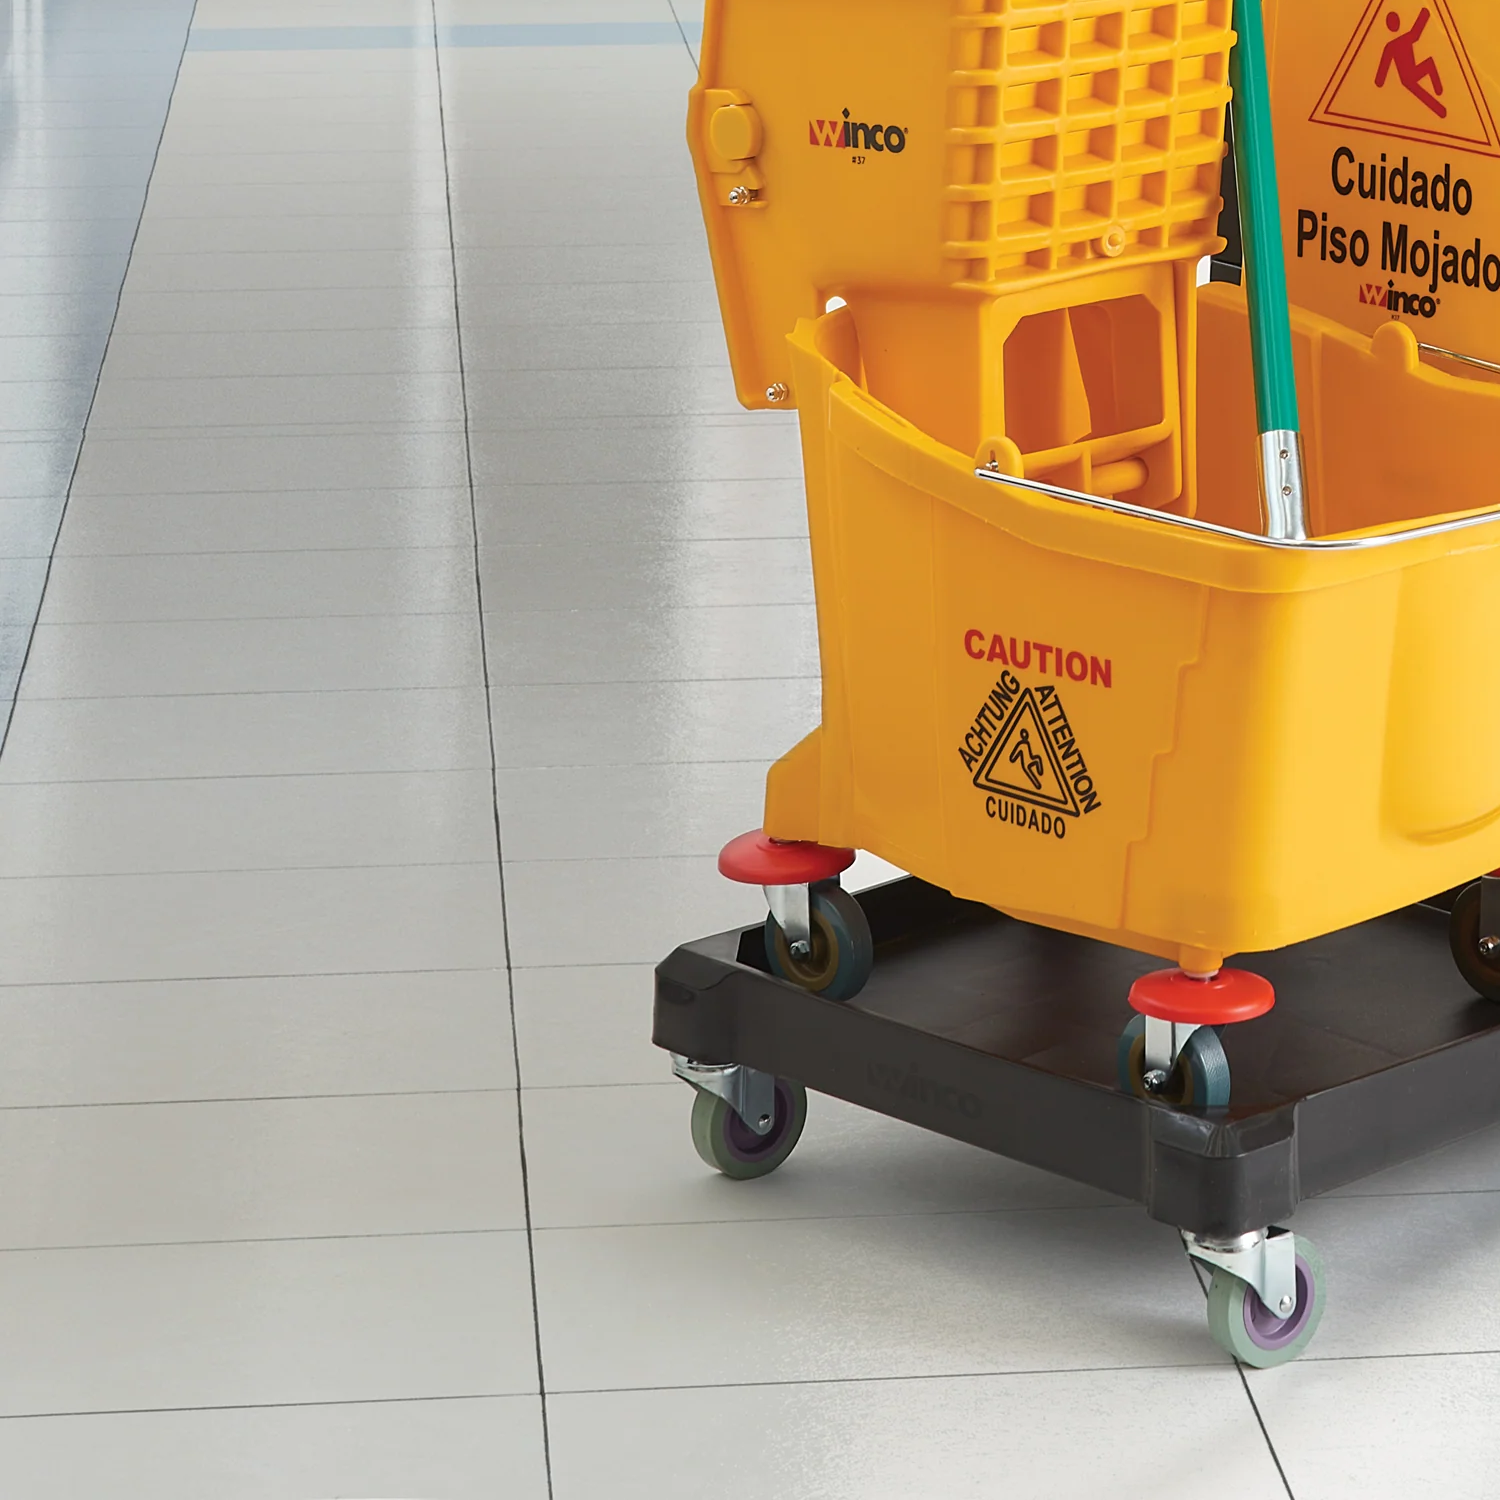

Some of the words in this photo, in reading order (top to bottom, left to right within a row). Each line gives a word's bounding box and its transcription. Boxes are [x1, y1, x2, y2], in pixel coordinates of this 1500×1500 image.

[1331, 146, 1473, 216] Cuidado
[1296, 208, 1370, 267] Piso
[963, 629, 1112, 688] CAUTION
[957, 669, 1021, 773] ACHTUNG
[1034, 685, 1102, 814] ATTENTION
[985, 796, 1066, 839] CUIDADO
